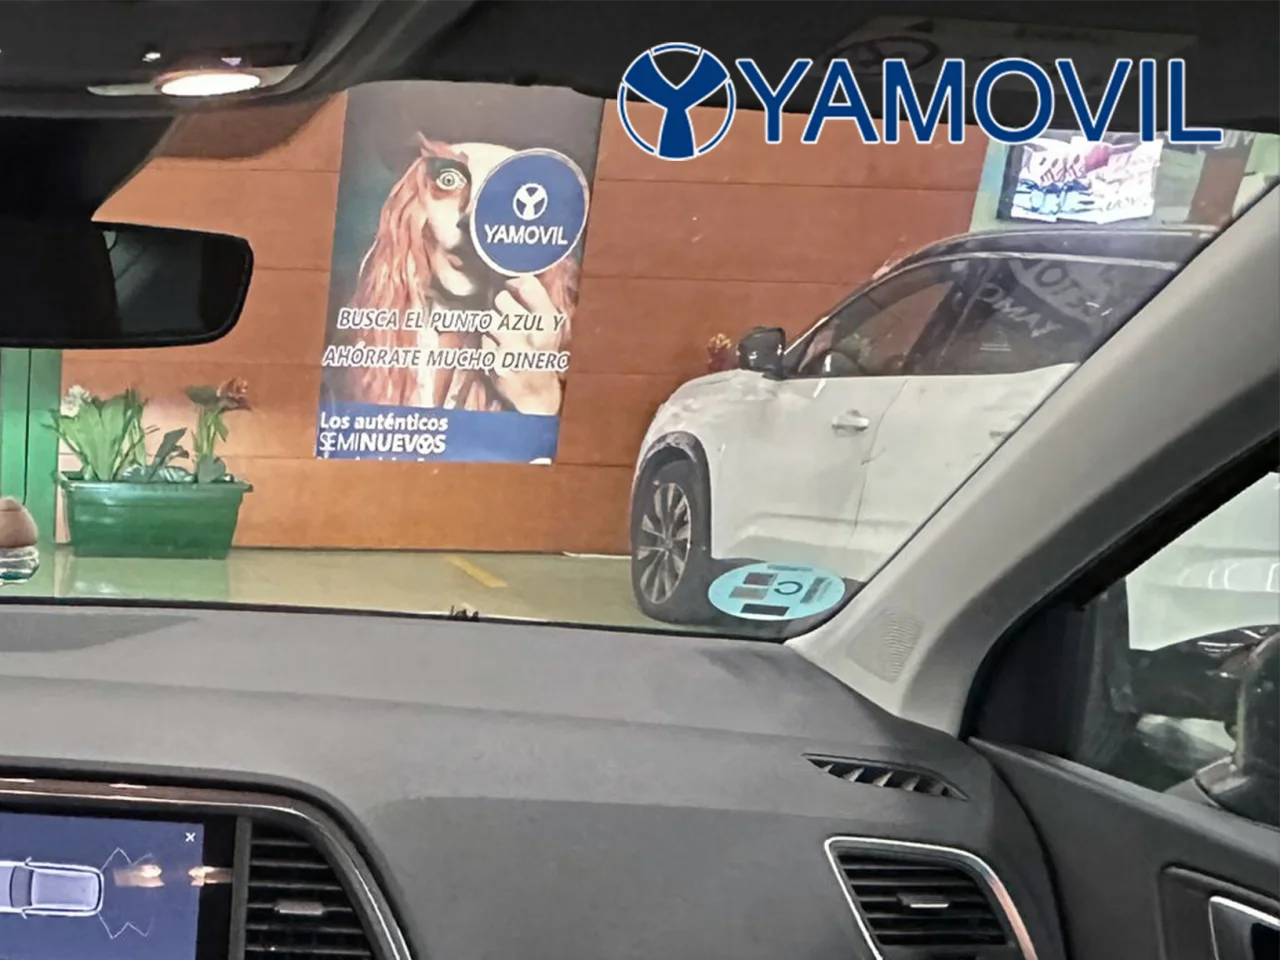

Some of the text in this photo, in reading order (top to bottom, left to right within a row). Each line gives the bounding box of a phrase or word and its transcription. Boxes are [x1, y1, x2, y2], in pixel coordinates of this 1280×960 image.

[483, 224, 568, 246] YAMOVIL
[337, 309, 566, 332] BUSCA EL PUNTO AZUL Y
[323, 342, 421, 367] AHÓRRATE
[426, 350, 496, 369] MUCHO
[320, 412, 449, 431] Los auténticos
